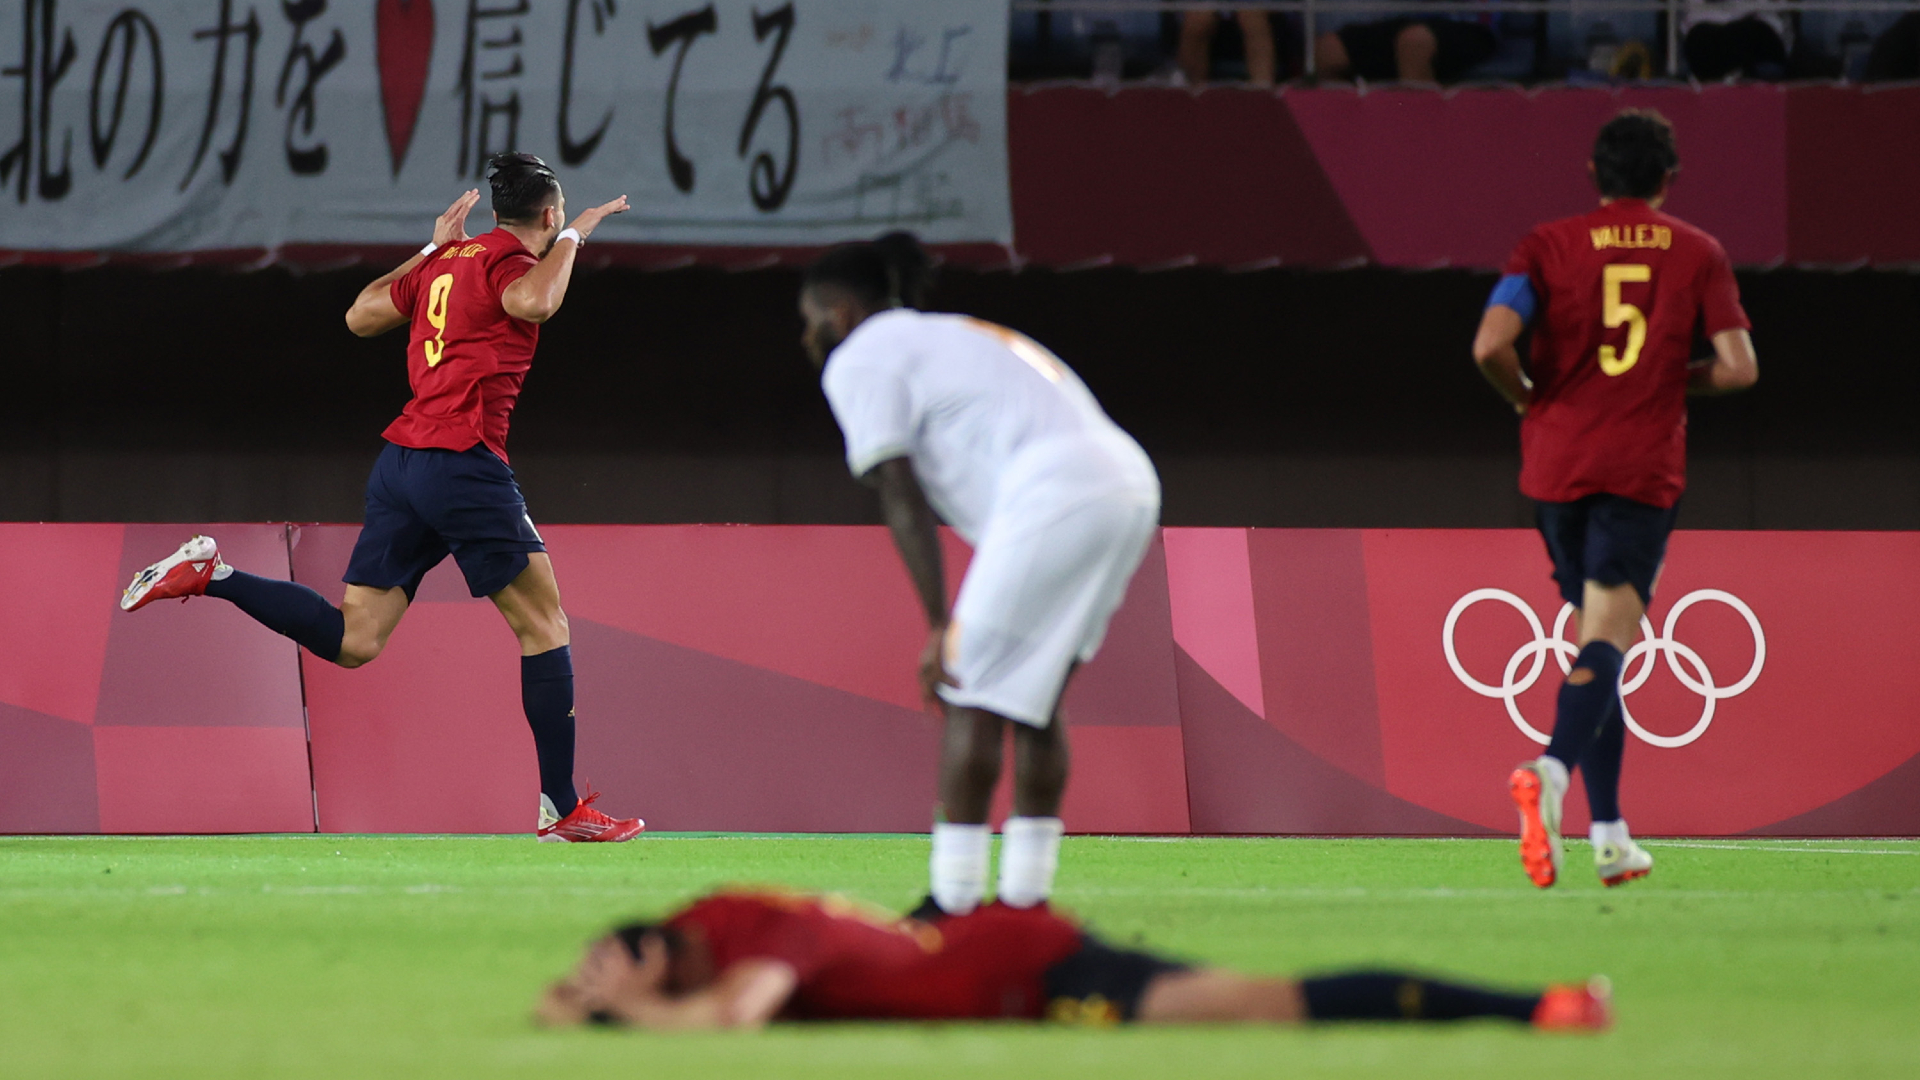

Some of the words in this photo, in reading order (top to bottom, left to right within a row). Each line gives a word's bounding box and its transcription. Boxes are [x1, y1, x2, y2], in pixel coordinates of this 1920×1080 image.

[1590, 224, 1673, 250] VALLEJO
[424, 273, 454, 368] 9
[1598, 263, 1652, 377] 5
